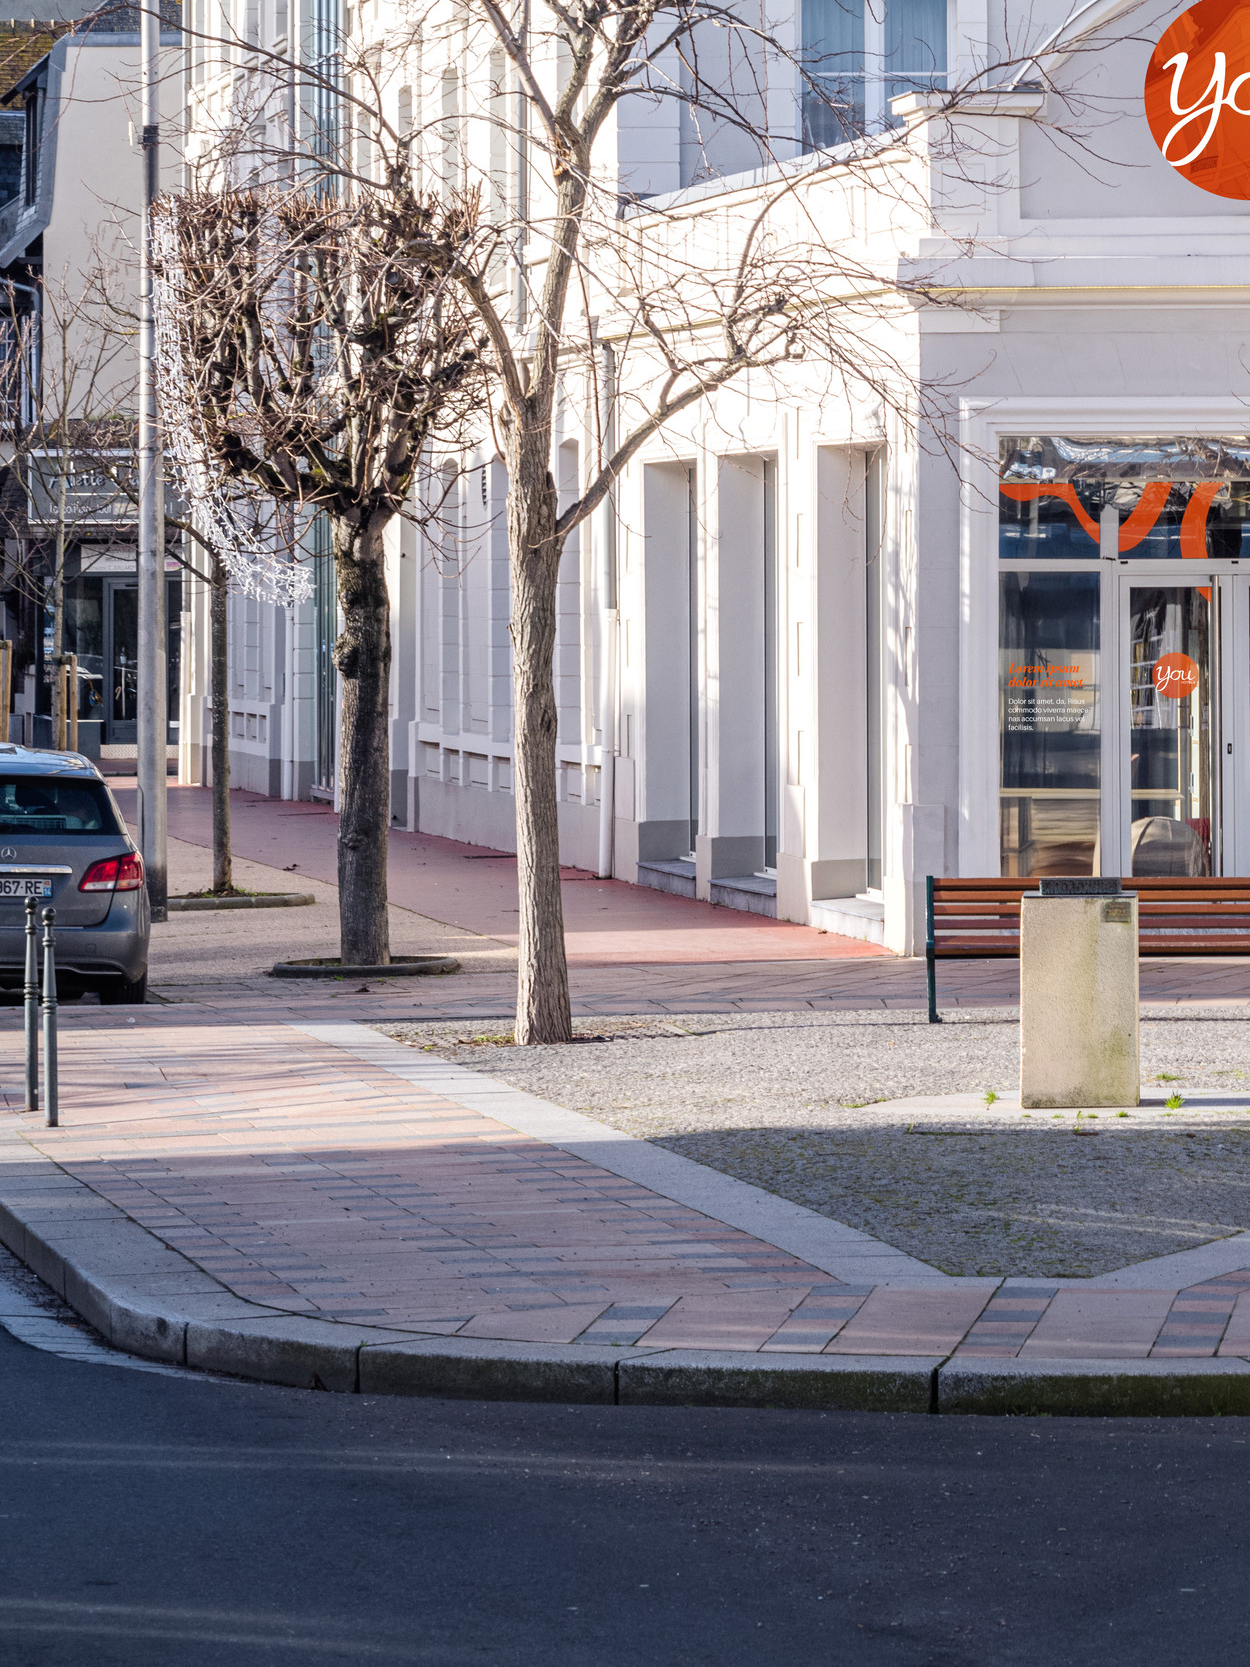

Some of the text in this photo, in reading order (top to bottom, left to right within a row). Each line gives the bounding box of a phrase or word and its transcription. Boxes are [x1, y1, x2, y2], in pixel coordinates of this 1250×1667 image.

[1008, 662, 1080, 675] Lorem ipsum
[1008, 677, 1085, 687] dolor sit amet.
